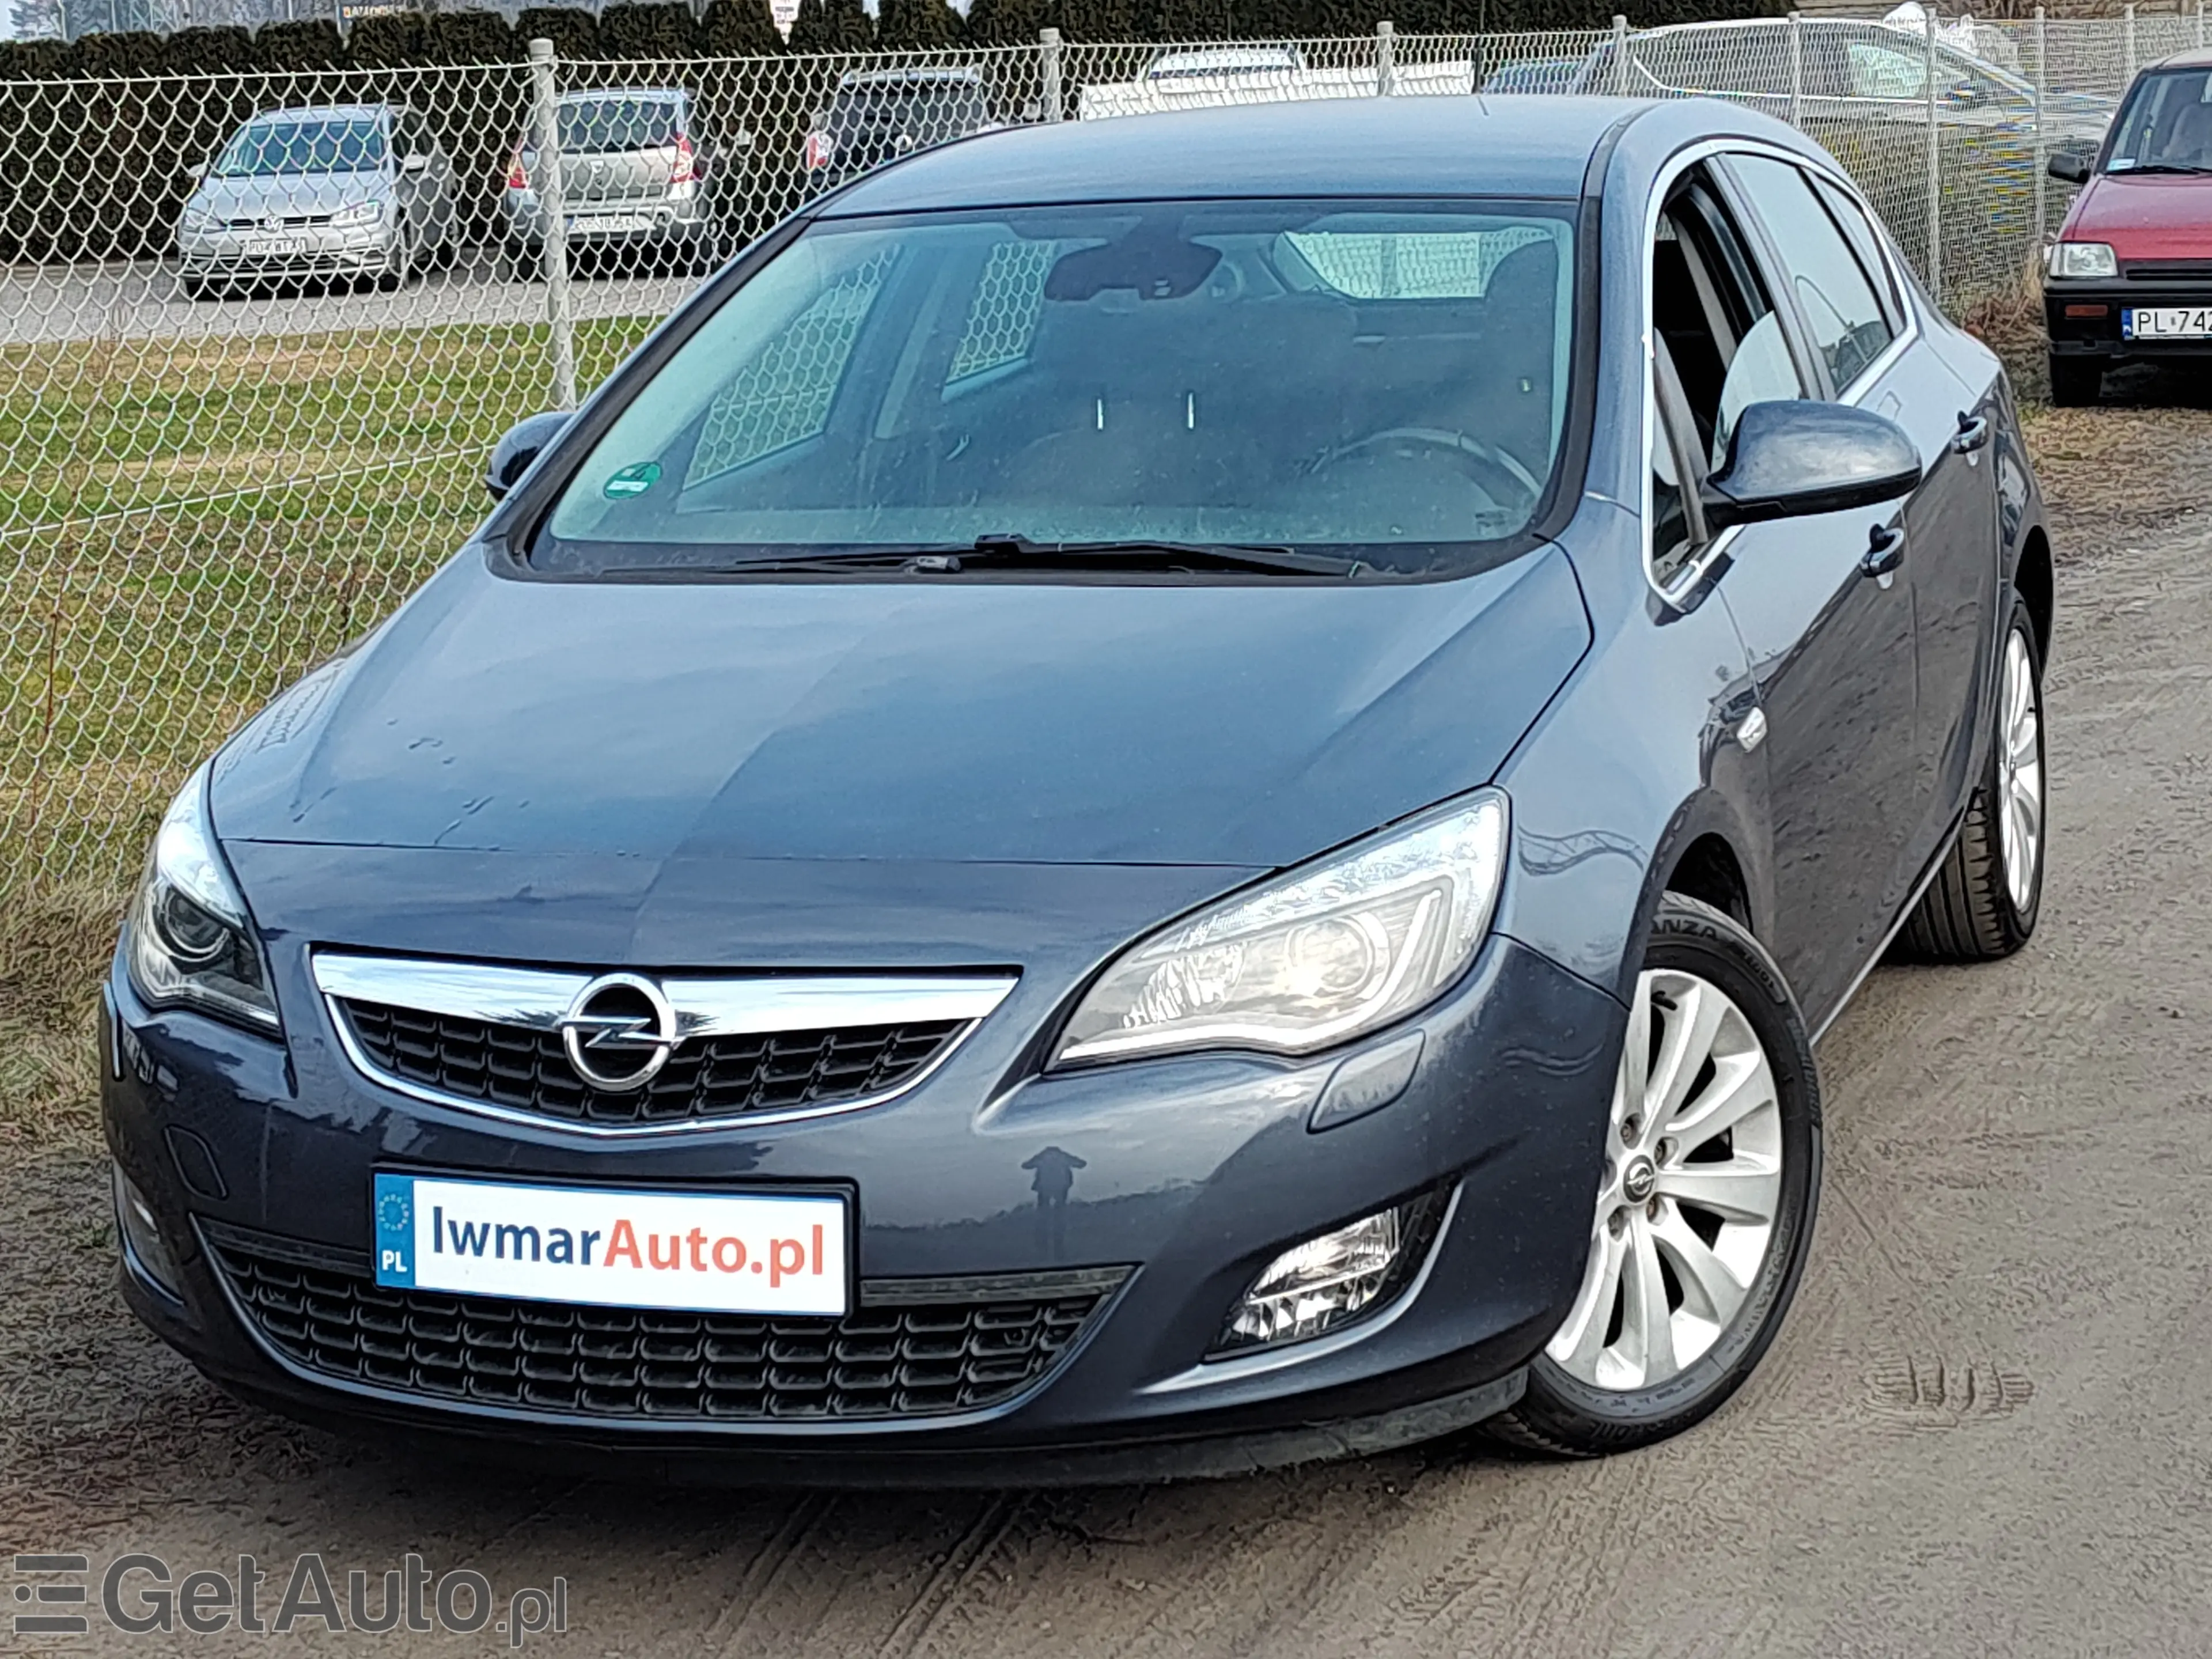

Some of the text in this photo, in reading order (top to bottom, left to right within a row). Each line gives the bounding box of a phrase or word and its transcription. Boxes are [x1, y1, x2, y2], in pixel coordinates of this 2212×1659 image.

[2138, 312, 2167, 332] PL
[433, 1206, 823, 1288] IwmarAuto.pl
[382, 1249, 408, 1272] PL
